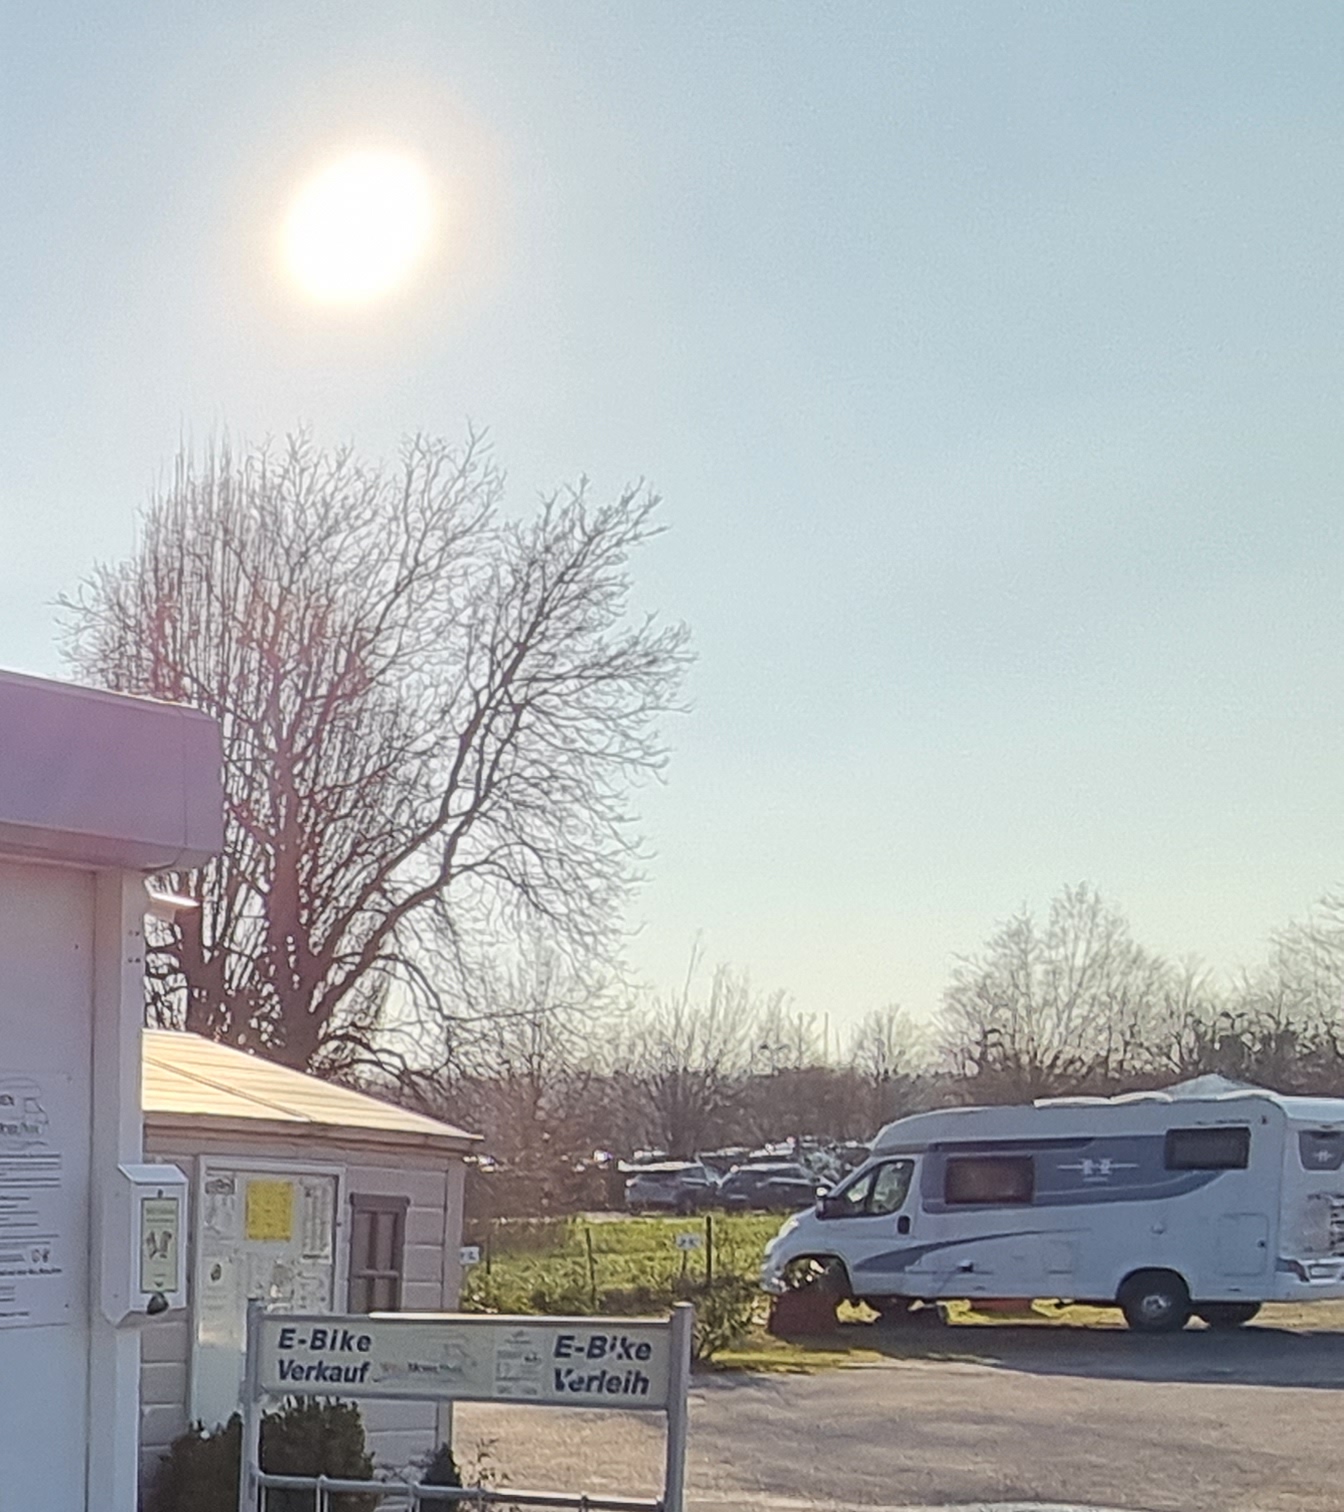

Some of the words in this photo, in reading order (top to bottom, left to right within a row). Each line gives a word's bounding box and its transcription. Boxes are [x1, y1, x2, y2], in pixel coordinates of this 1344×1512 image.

[278, 1328, 372, 1353] E-Bike
[553, 1334, 652, 1361] E-Bike
[277, 1359, 370, 1384] Verkauf
[553, 1367, 650, 1395] Verleih
